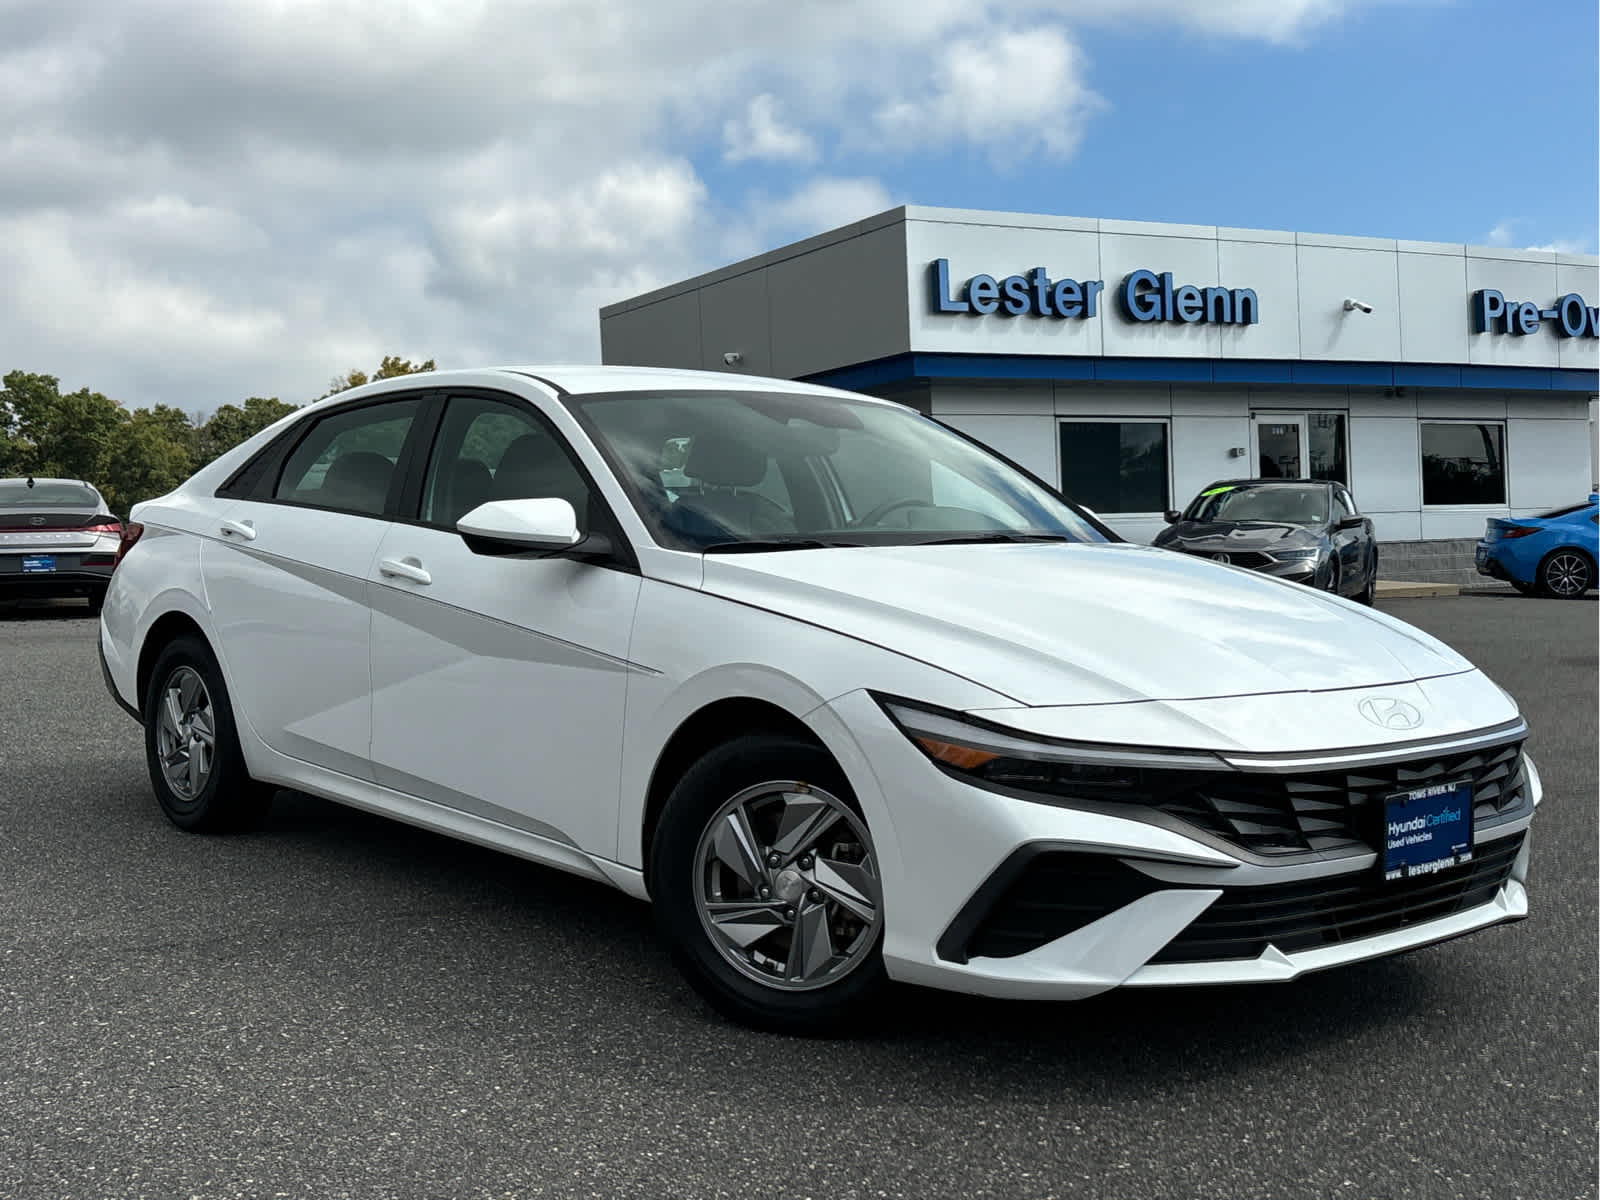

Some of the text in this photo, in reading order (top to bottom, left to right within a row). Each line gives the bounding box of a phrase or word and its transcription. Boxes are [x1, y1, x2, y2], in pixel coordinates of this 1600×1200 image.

[932, 258, 1104, 319] Lester
[1121, 269, 1258, 324] Glenn
[1387, 832, 1433, 849] Used Vehicles
